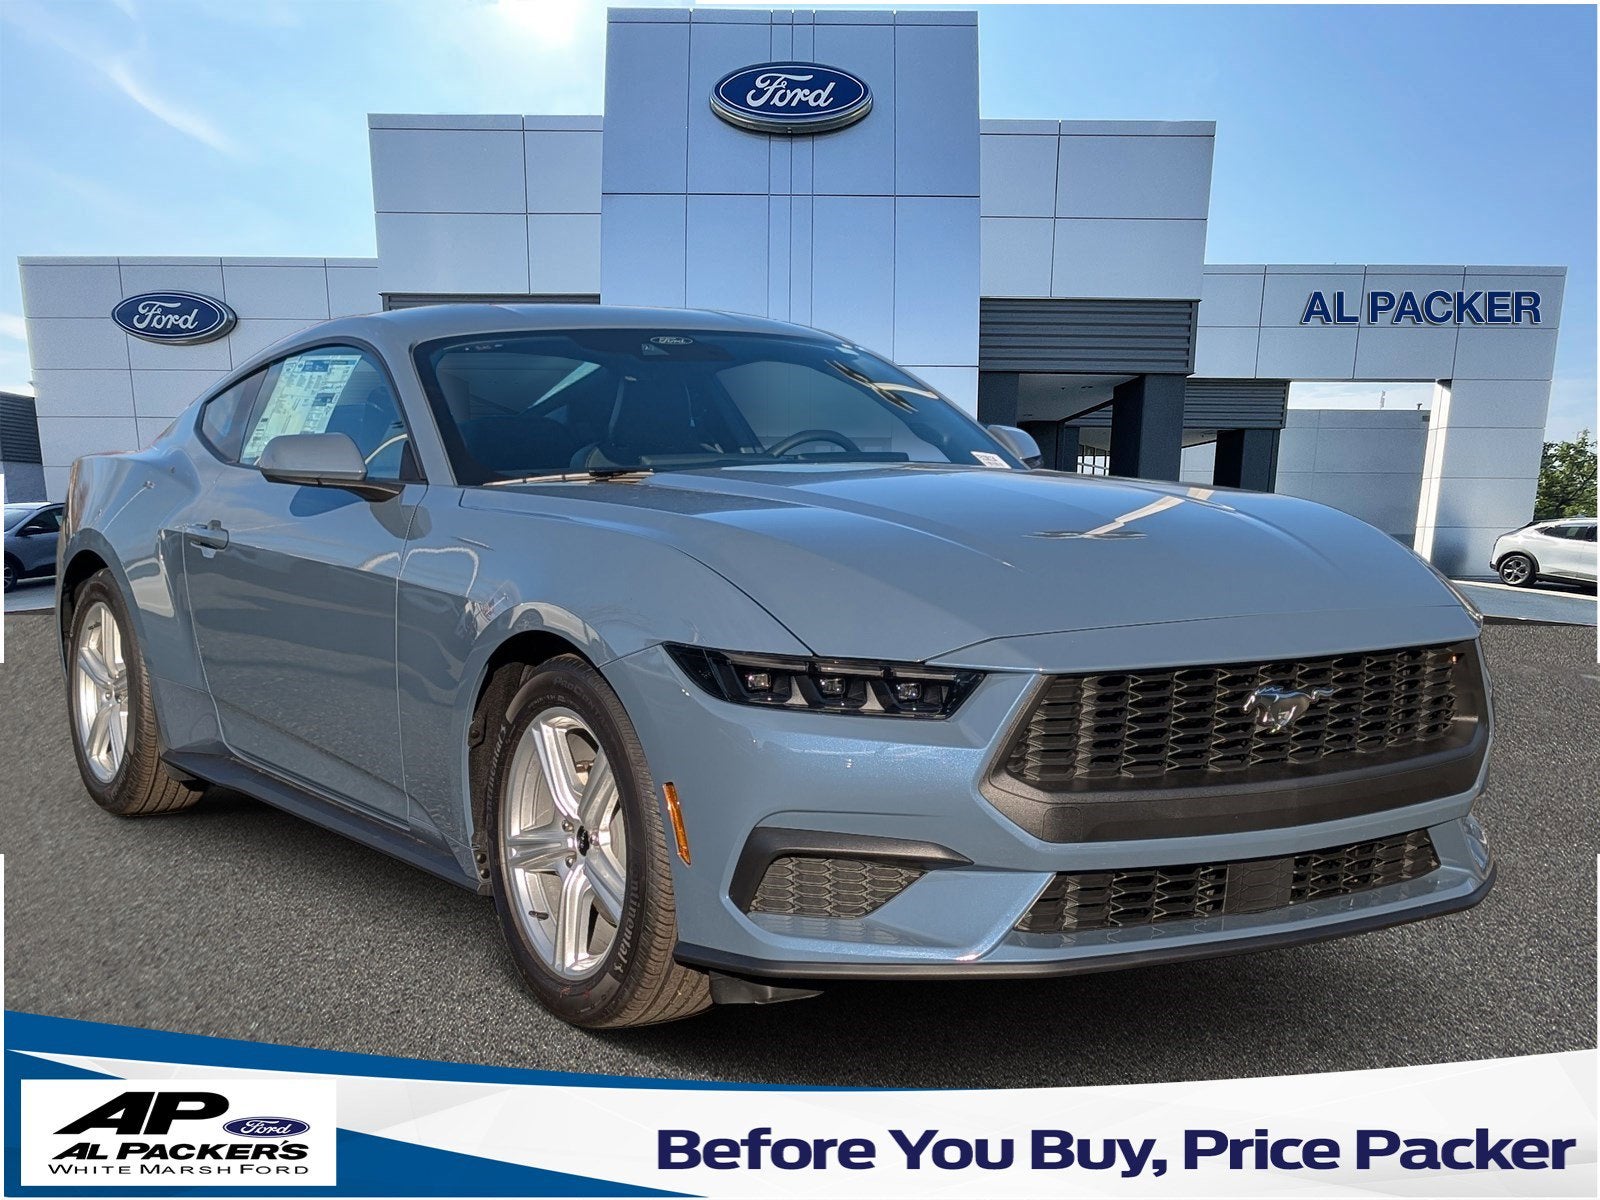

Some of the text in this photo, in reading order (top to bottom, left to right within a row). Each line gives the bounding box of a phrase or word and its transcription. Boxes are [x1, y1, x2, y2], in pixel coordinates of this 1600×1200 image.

[746, 73, 836, 108] Ford
[133, 301, 199, 329] Ford
[1302, 290, 1542, 325] AL PACKER
[616, 852, 641, 965] ontinental
